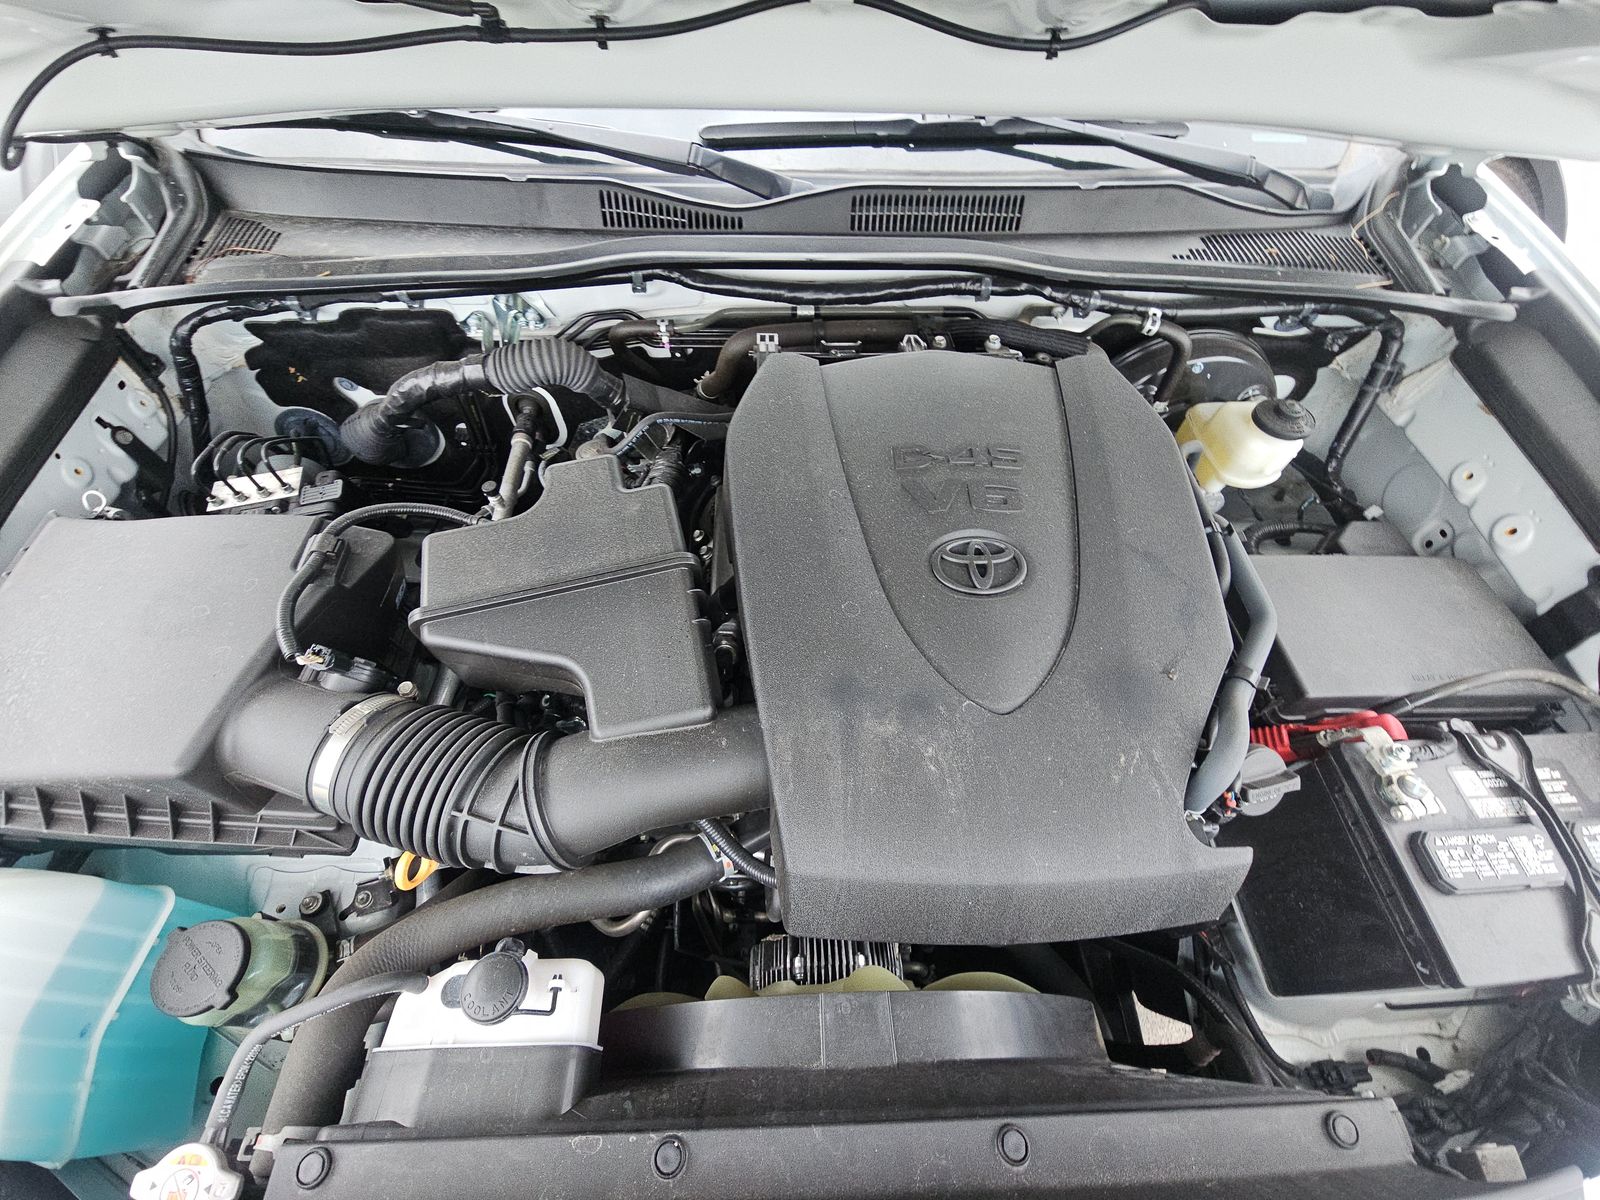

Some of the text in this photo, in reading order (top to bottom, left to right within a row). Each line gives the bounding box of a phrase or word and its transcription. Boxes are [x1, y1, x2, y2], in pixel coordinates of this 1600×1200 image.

[897, 479, 1024, 513] V6
[182, 934, 201, 960] POWER
[197, 955, 223, 988] STEERING
[463, 987, 514, 1017] COOLANT
